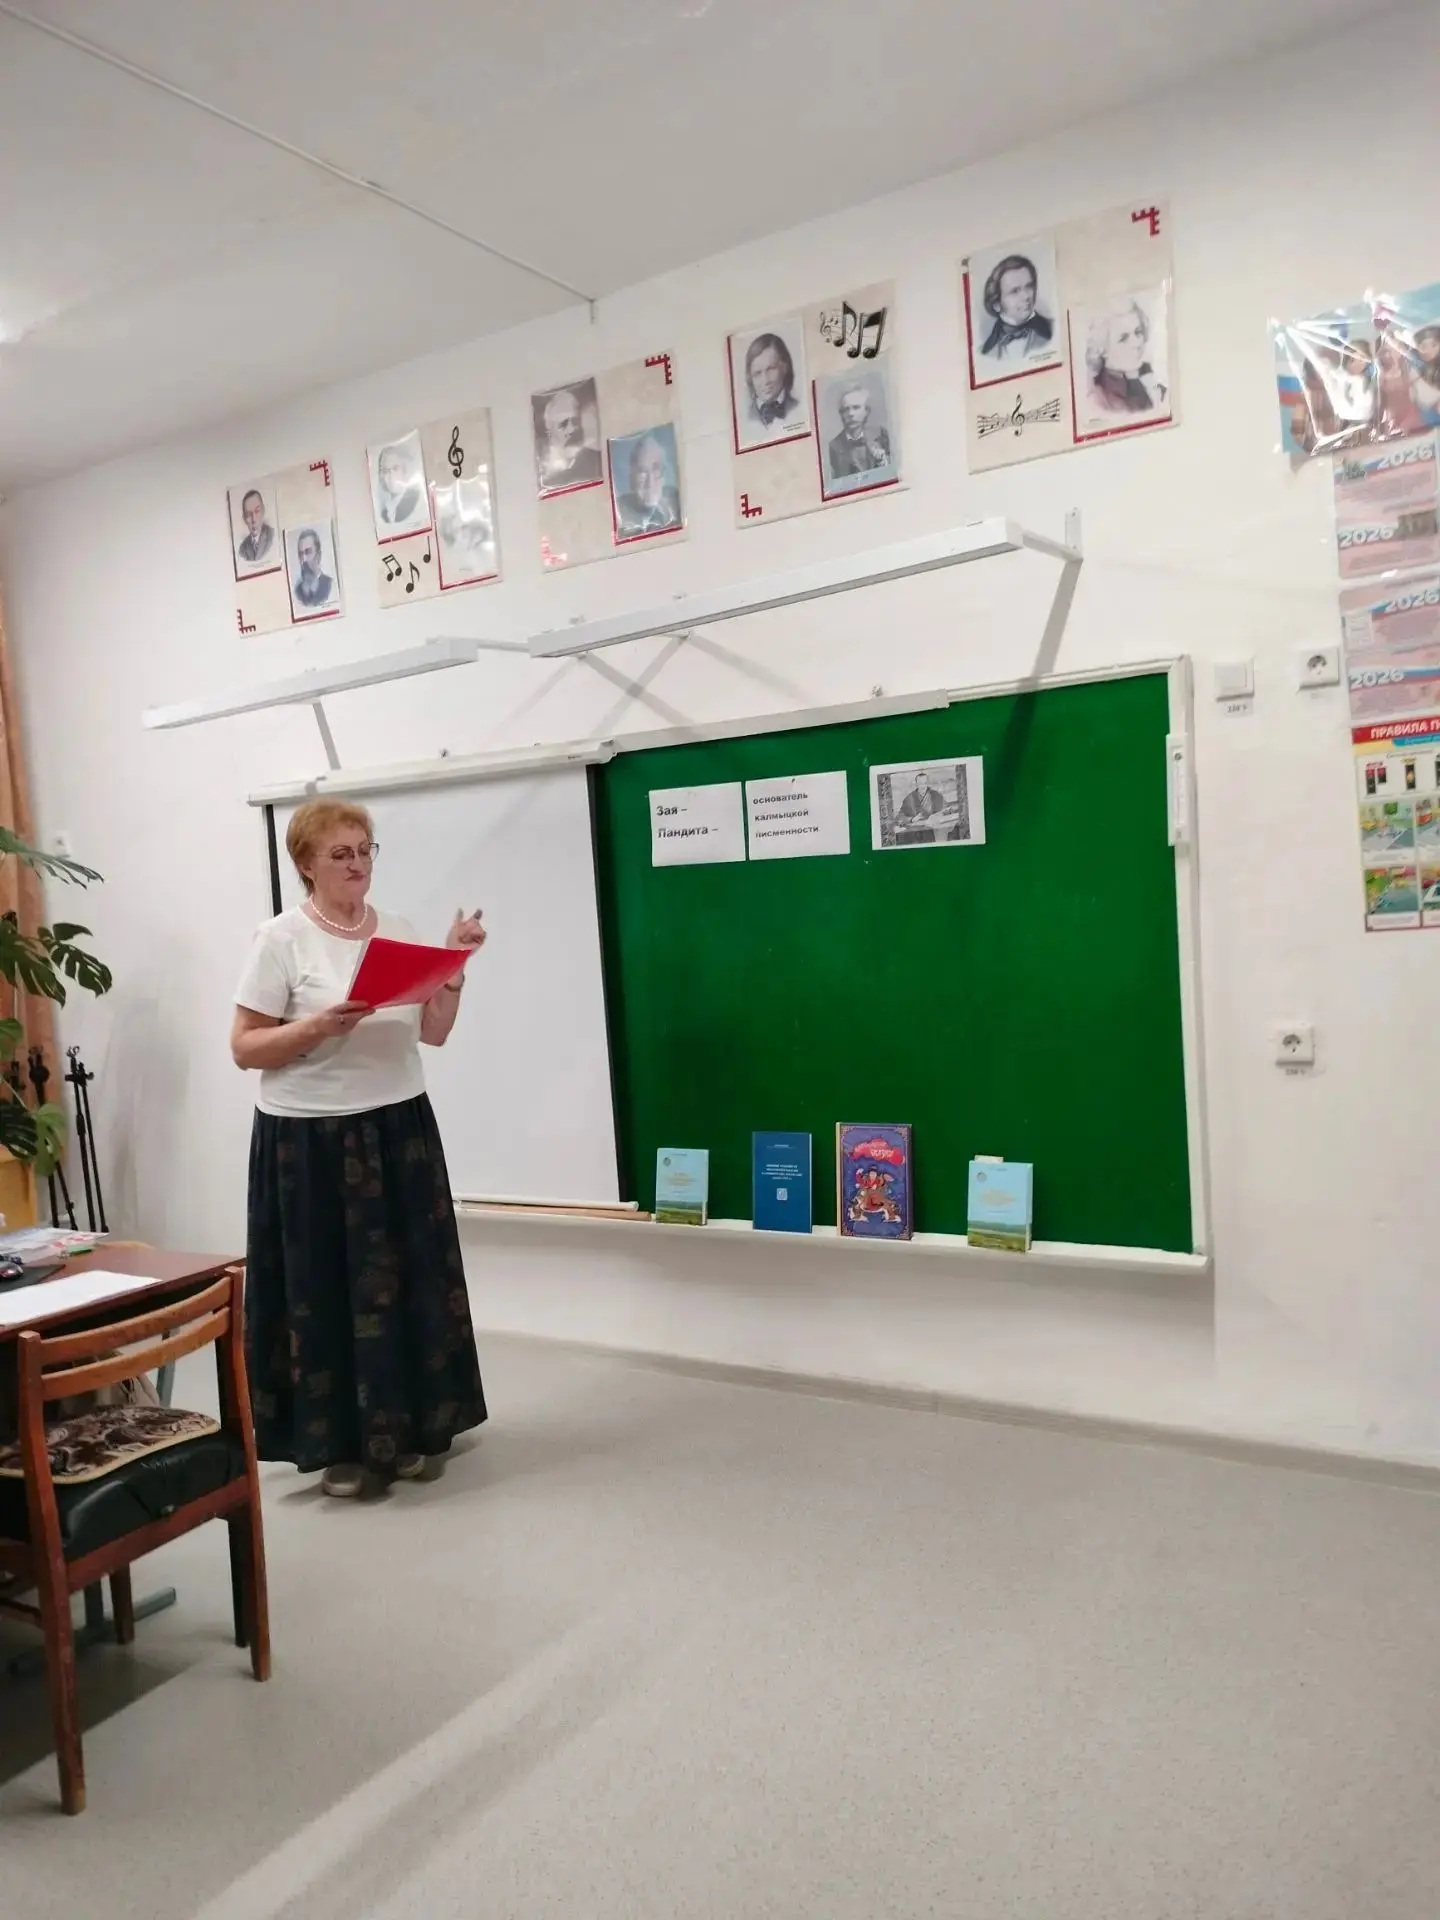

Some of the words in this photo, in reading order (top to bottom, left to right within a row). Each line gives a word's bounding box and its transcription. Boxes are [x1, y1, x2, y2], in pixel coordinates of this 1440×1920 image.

[1376, 443, 1433, 471] 2026
[1338, 526, 1395, 549] 2026
[1384, 590, 1440, 613] 2026
[1348, 668, 1405, 691] 2026
[1370, 721, 1428, 740] ПРАВИЛА
[753, 792, 808, 805] основатель
[656, 805, 678, 816] Зая
[754, 808, 809, 822] калмыцкой
[657, 826, 708, 839] Пандита
